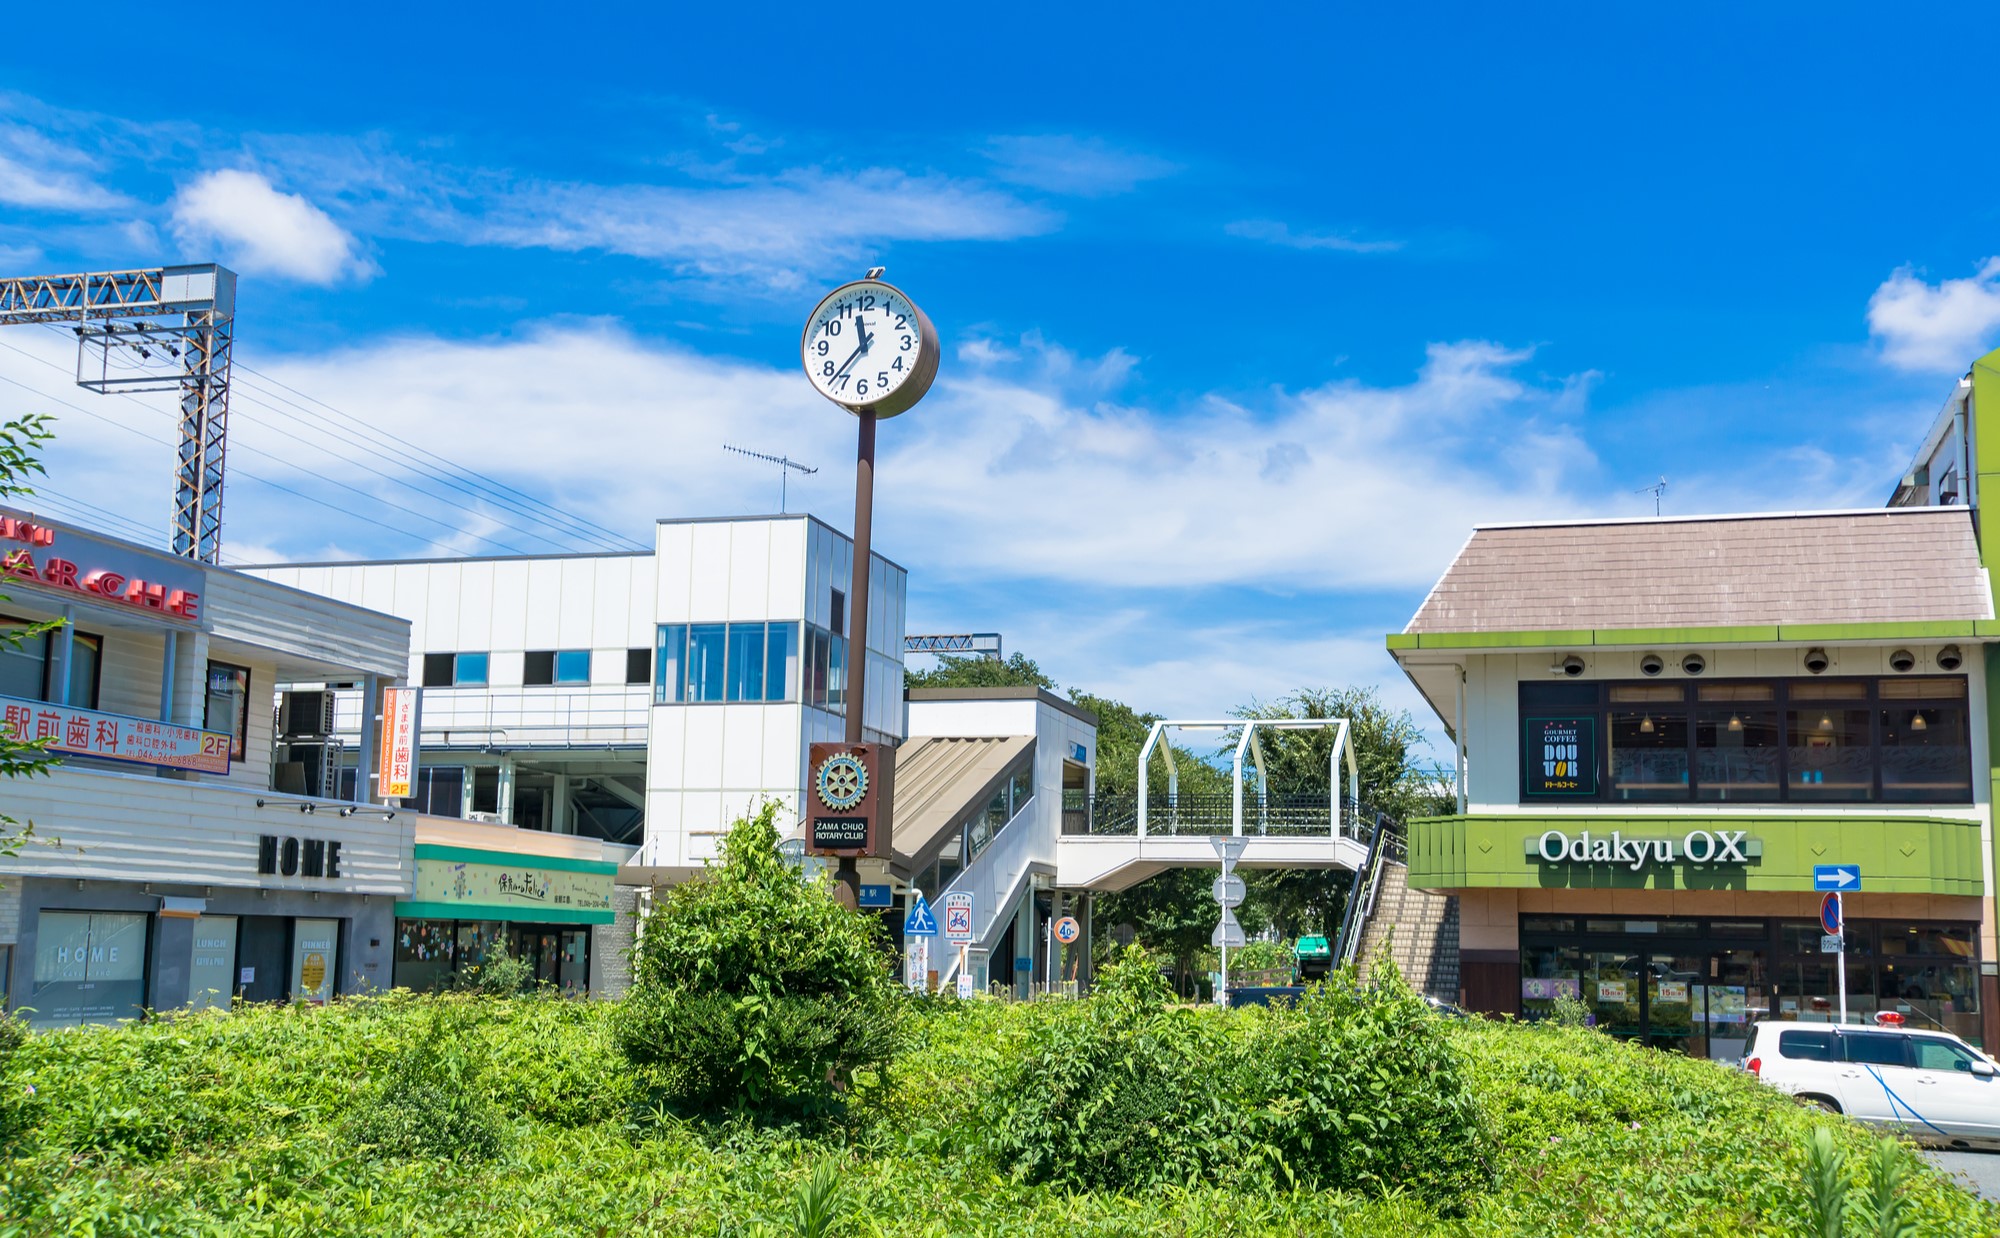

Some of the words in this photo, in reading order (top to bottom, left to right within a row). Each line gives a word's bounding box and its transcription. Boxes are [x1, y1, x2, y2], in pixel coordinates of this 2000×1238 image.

[837, 303, 852, 319] 11
[856, 295, 875, 311] 12
[882, 301, 890, 316] 1
[822, 320, 841, 336] 10
[895, 314, 906, 330] 2
[818, 340, 829, 356] 9
[900, 335, 911, 351] 3
[823, 361, 834, 376] 8
[891, 356, 903, 372] 4
[839, 374, 850, 390] 7
[857, 379, 868, 395] 6
[877, 372, 888, 387] 5
[5, 705, 119, 753] 駅前歯科
[203, 736, 228, 755] 2F
[1544, 744, 1578, 760] DOU
[391, 784, 409, 795] 2F
[816, 823, 839, 831] ZAMA
[841, 822, 864, 831] CHUO
[258, 834, 342, 878] HOME
[1538, 830, 1676, 871] Odakyu
[1683, 830, 1748, 862] OX
[196, 939, 227, 948] LUNCH
[58, 946, 118, 963] HOME
